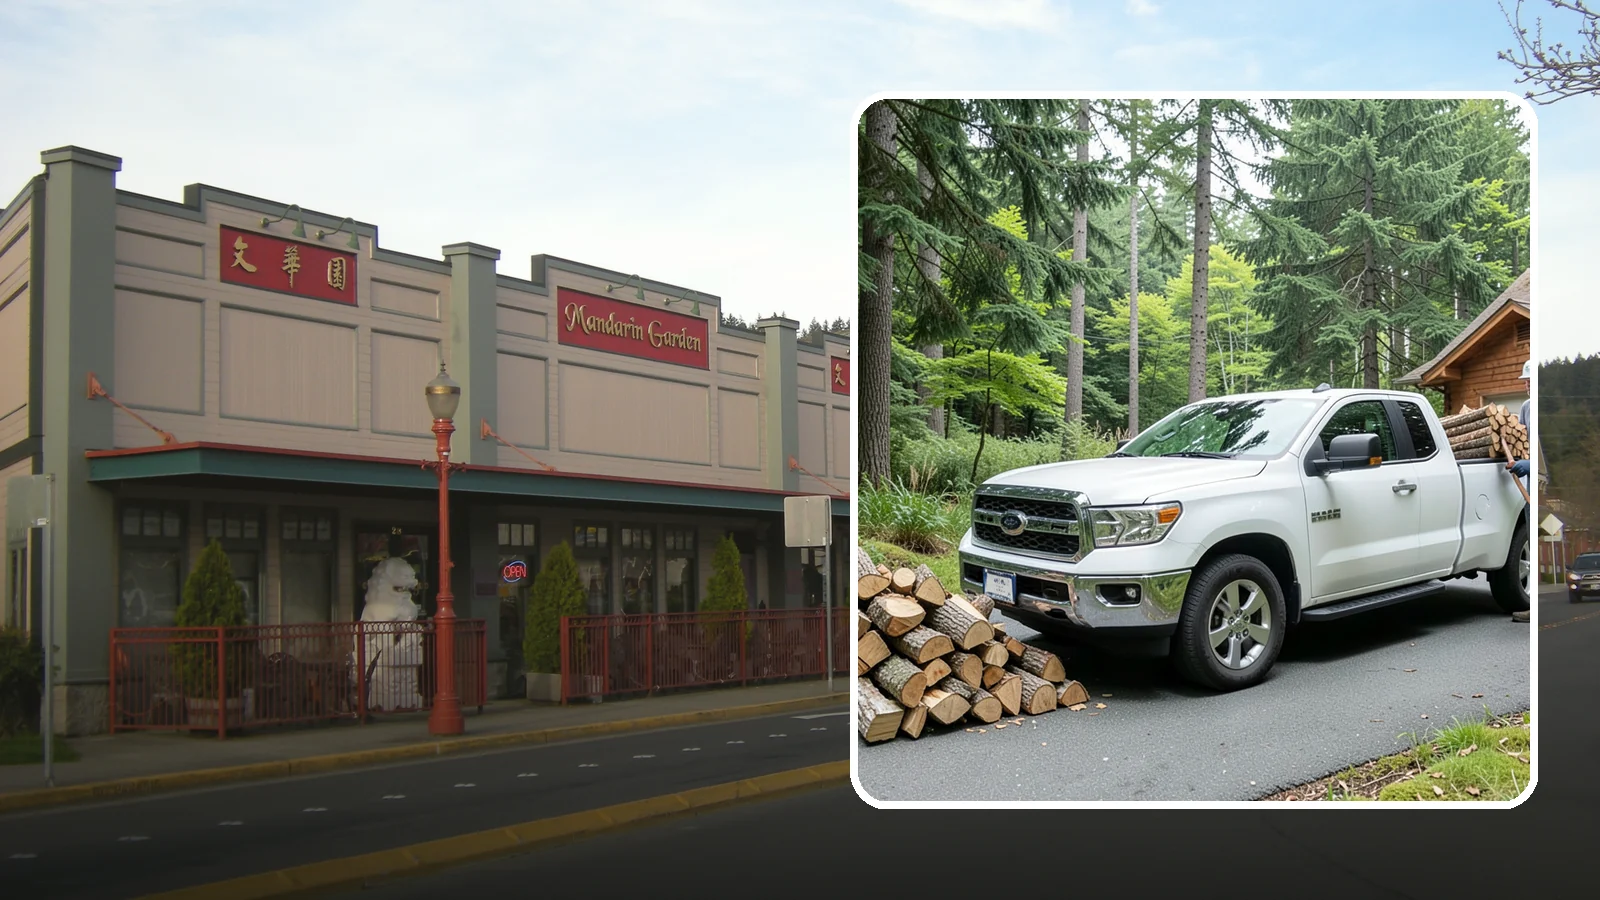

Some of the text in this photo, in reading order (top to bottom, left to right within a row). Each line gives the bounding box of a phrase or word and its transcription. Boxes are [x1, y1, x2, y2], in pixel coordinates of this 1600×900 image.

[231, 236, 346, 291] 文華園
[564, 302, 701, 352] Mandarin Garden
[834, 363, 846, 386] 文
[503, 565, 527, 578] OPEN
